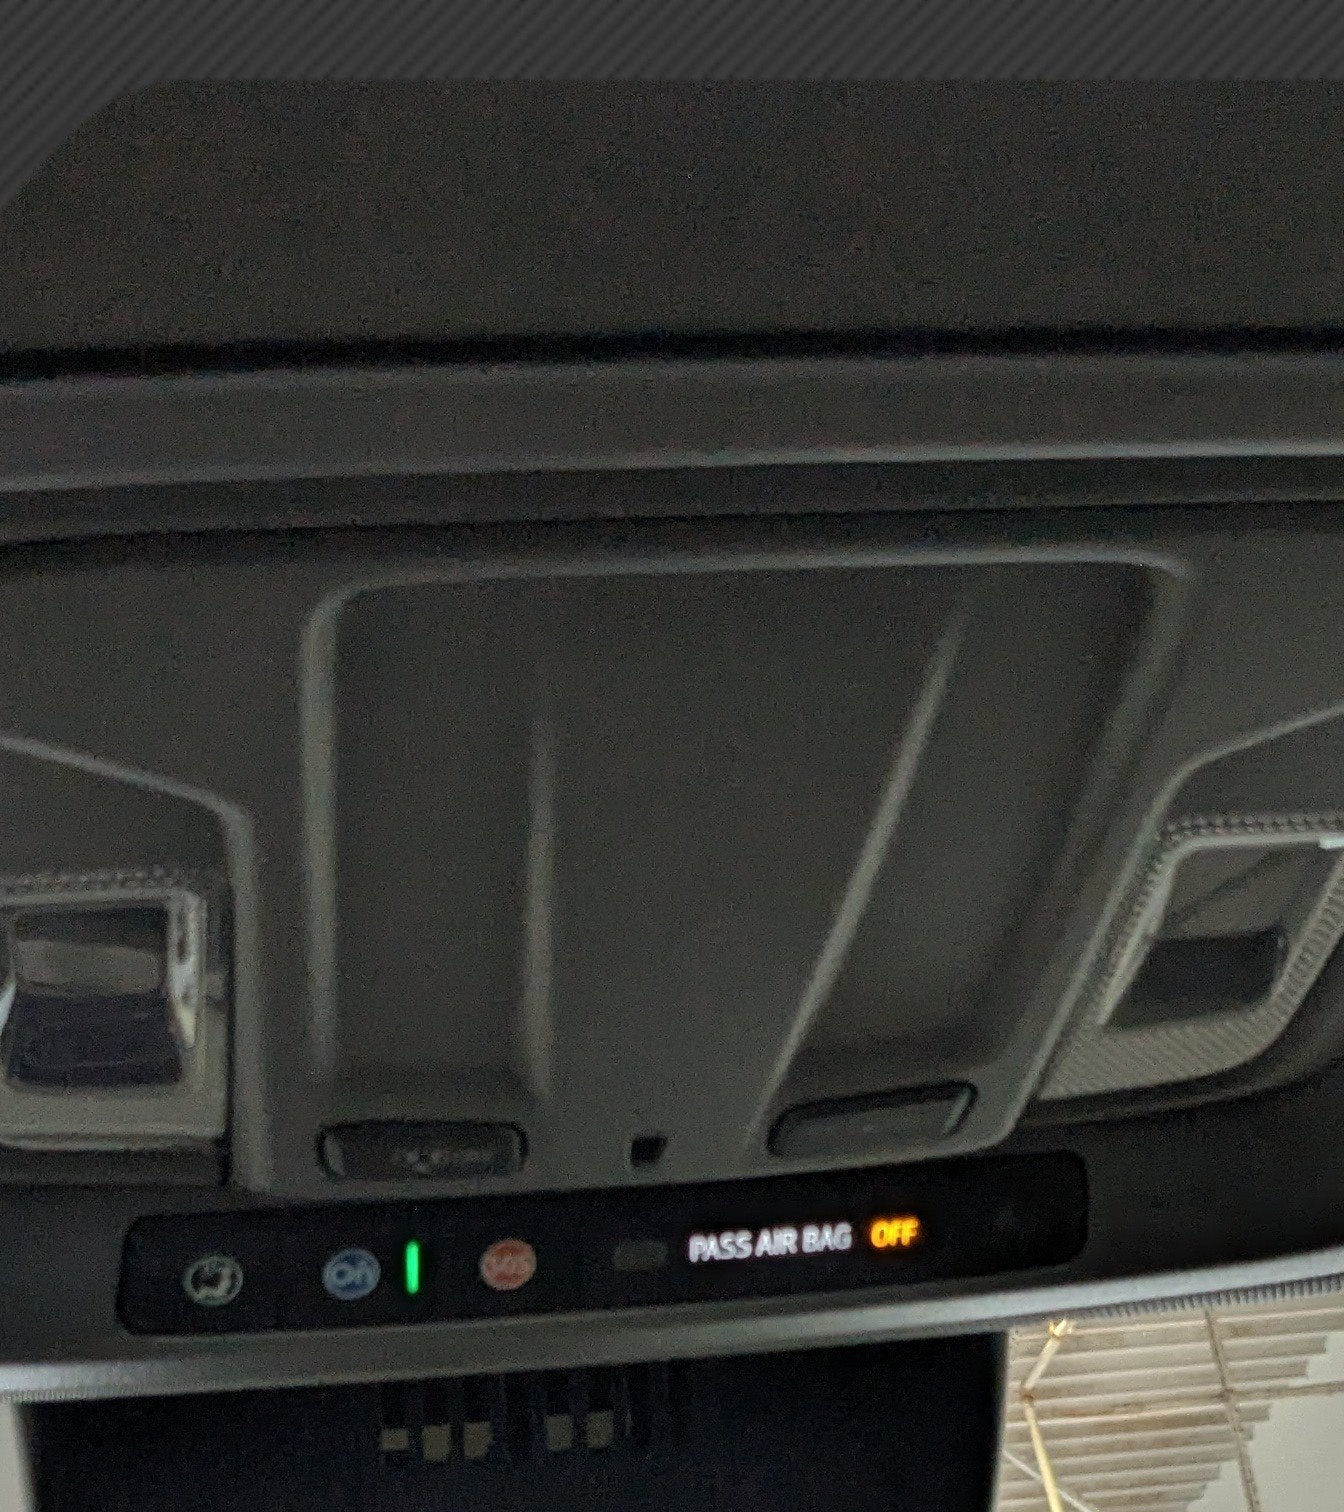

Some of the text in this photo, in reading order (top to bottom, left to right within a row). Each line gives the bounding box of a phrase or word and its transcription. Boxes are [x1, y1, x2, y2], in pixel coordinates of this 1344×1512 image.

[688, 1215, 921, 1263] PASS AIR BAG OFF
